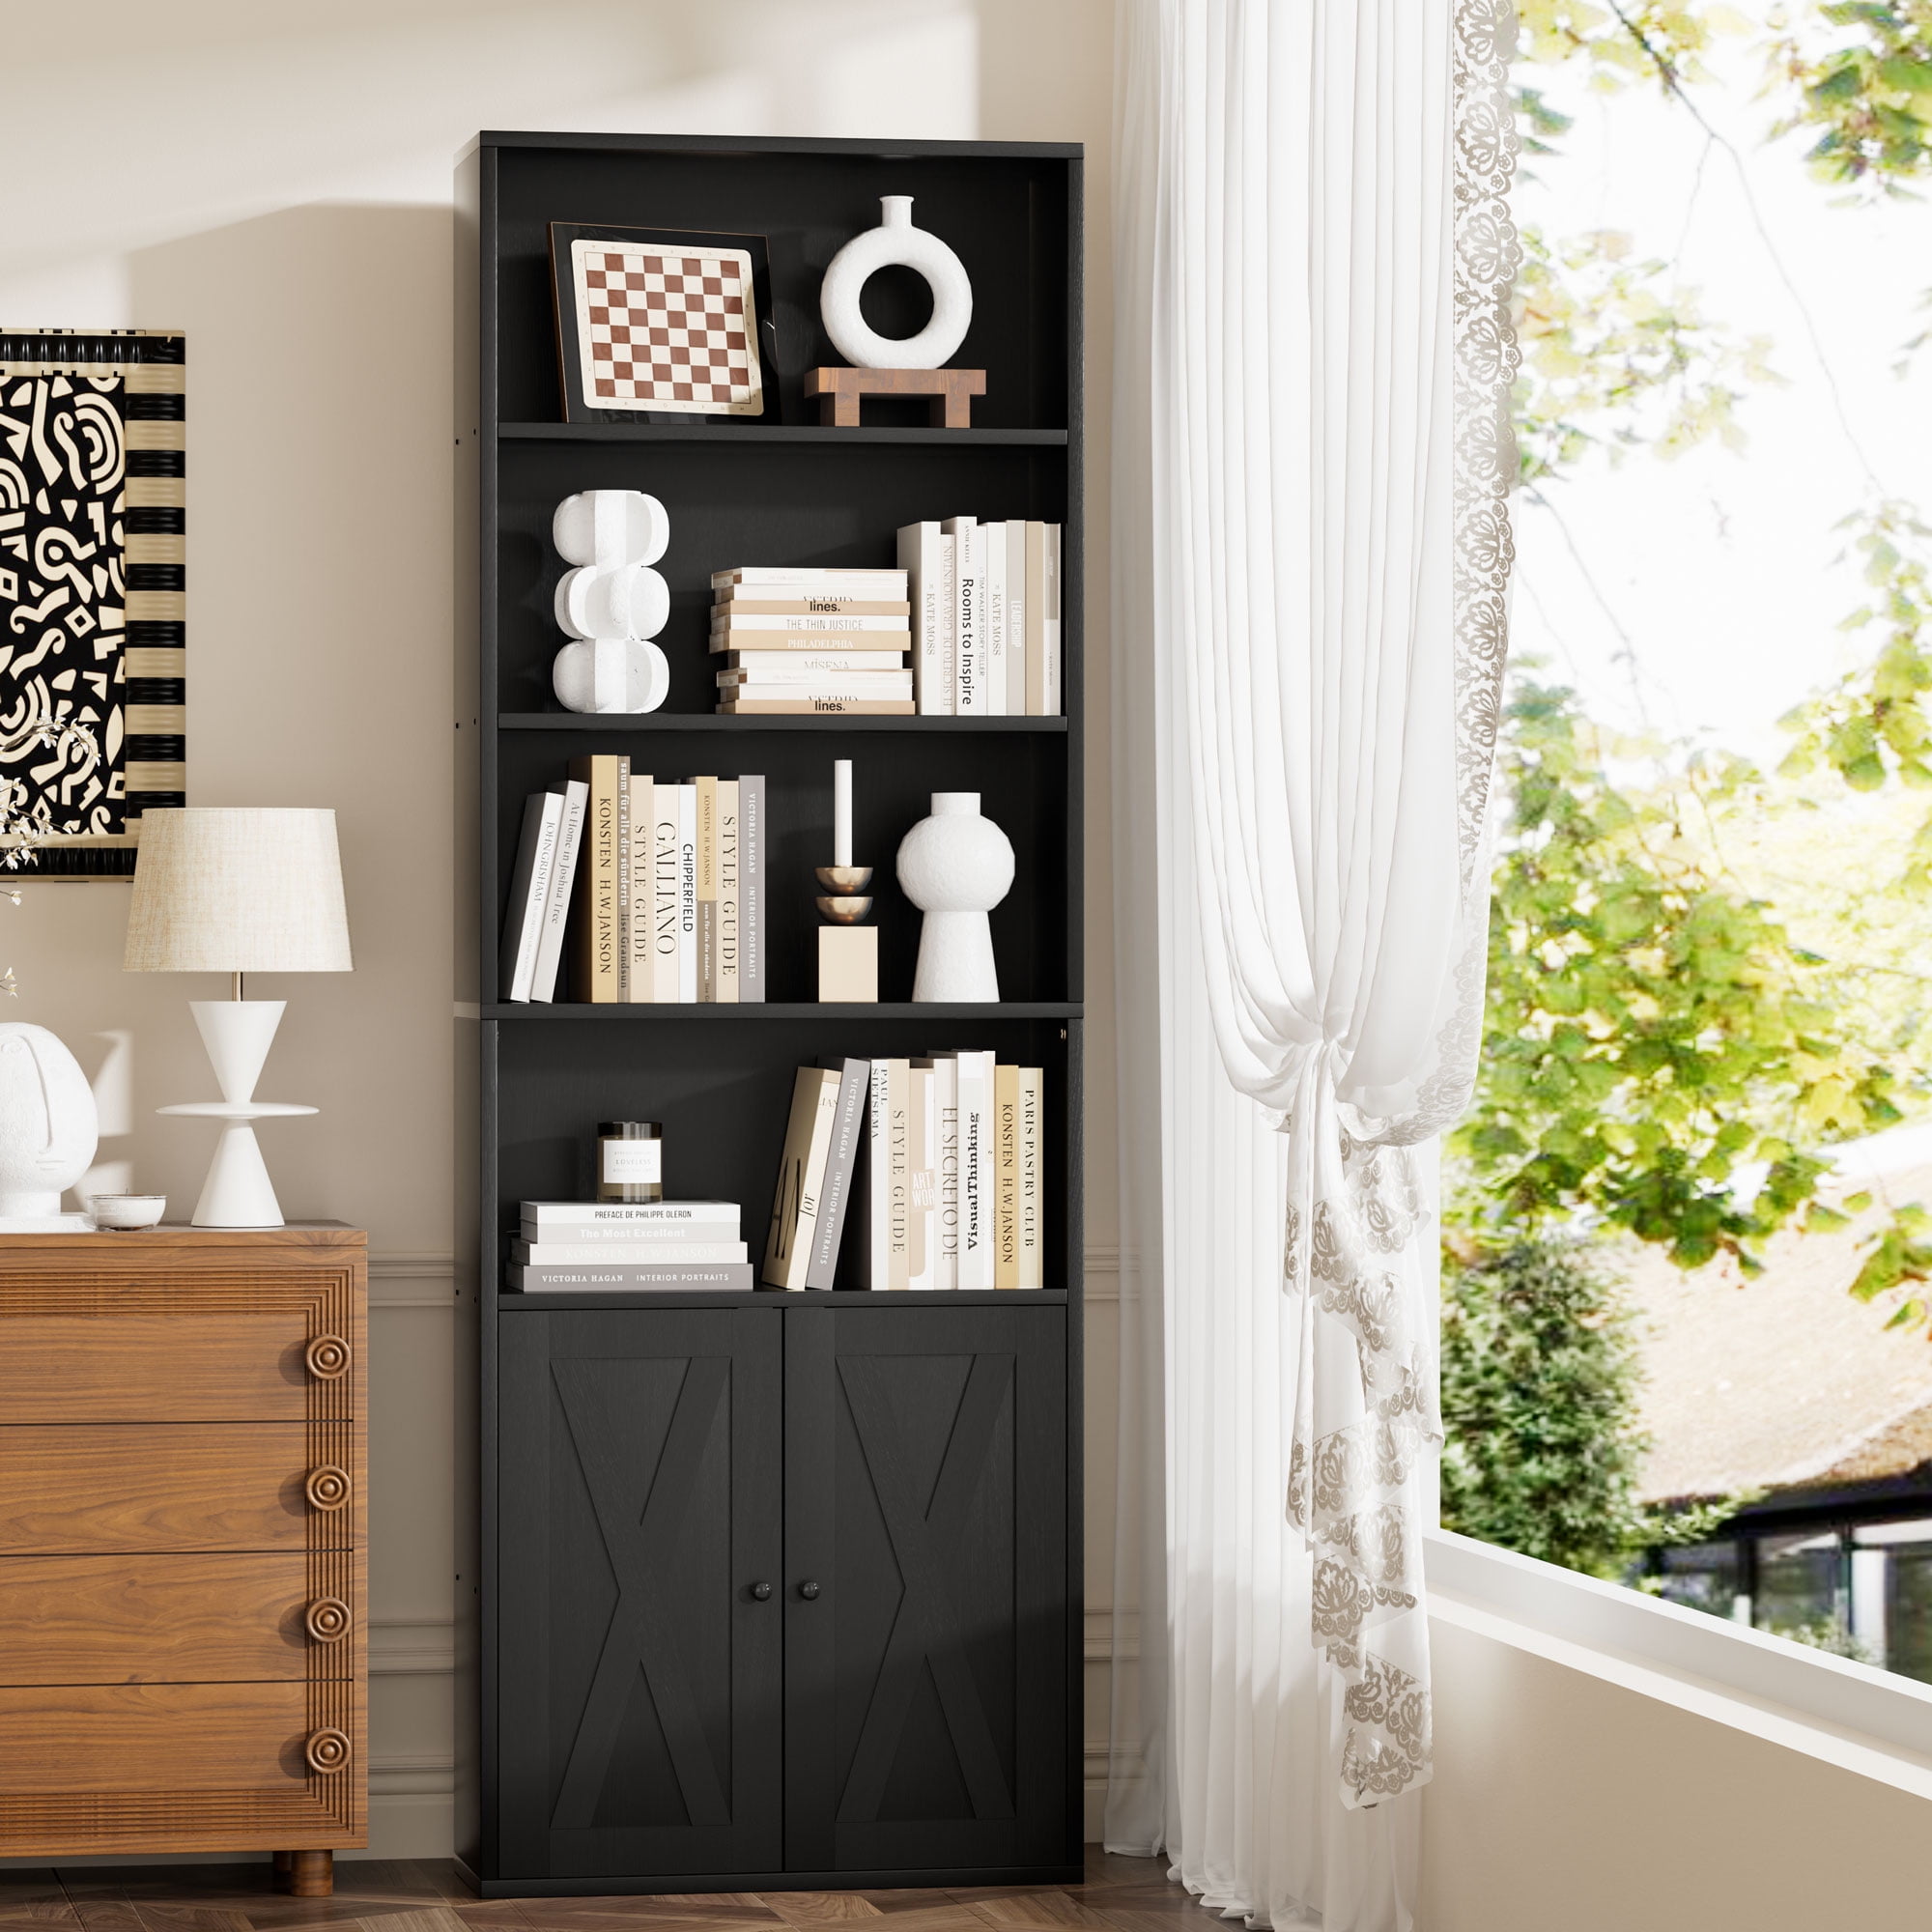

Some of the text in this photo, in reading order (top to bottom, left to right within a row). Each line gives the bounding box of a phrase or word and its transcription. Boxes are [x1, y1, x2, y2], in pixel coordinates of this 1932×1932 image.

[786, 619, 864, 630] THE THIN JUSTICE
[810, 601, 840, 611] lines.
[926, 593, 936, 656] KATE MOSS
[943, 546, 953, 706] EL SECRETO DE GRAY MOUNTAIN
[992, 593, 1002, 656] KATE MOSS
[1010, 600, 1022, 648] LEADERSHIP
[787, 639, 855, 649] PHILADELPHIA
[959, 579, 975, 705] Rooms to Inspire
[814, 700, 846, 712] lines.
[565, 818, 578, 848] Home
[620, 814, 630, 834] alla
[620, 838, 630, 855] die
[556, 862, 570, 898] Joshua
[561, 851, 571, 861] in
[552, 903, 563, 924] Tree
[597, 798, 611, 974] KONSTEN H.W.JANSON
[635, 825, 646, 963] STYLE GUIDE
[656, 822, 675, 954] GALLIANO
[682, 843, 694, 932] CHIPPERFIELD
[723, 816, 736, 975] STYLE GUIDE
[820, 1078, 859, 1264] VICTORIA HAGAN INTERIOR PORTRAITS
[893, 1110, 905, 1253] STYLE GUIDE
[913, 1172, 931, 1189] ART
[942, 1107, 957, 1260] EL SECRETO DE
[1001, 1104, 1013, 1264] KONSTEN H.W.JANSON
[1025, 1090, 1035, 1247] PARIS PASTRY CLUB
[580, 1228, 686, 1238] The Most Excellent
[625, 1210, 634, 1219] DE
[635, 1210, 665, 1219] PHILIPPE
